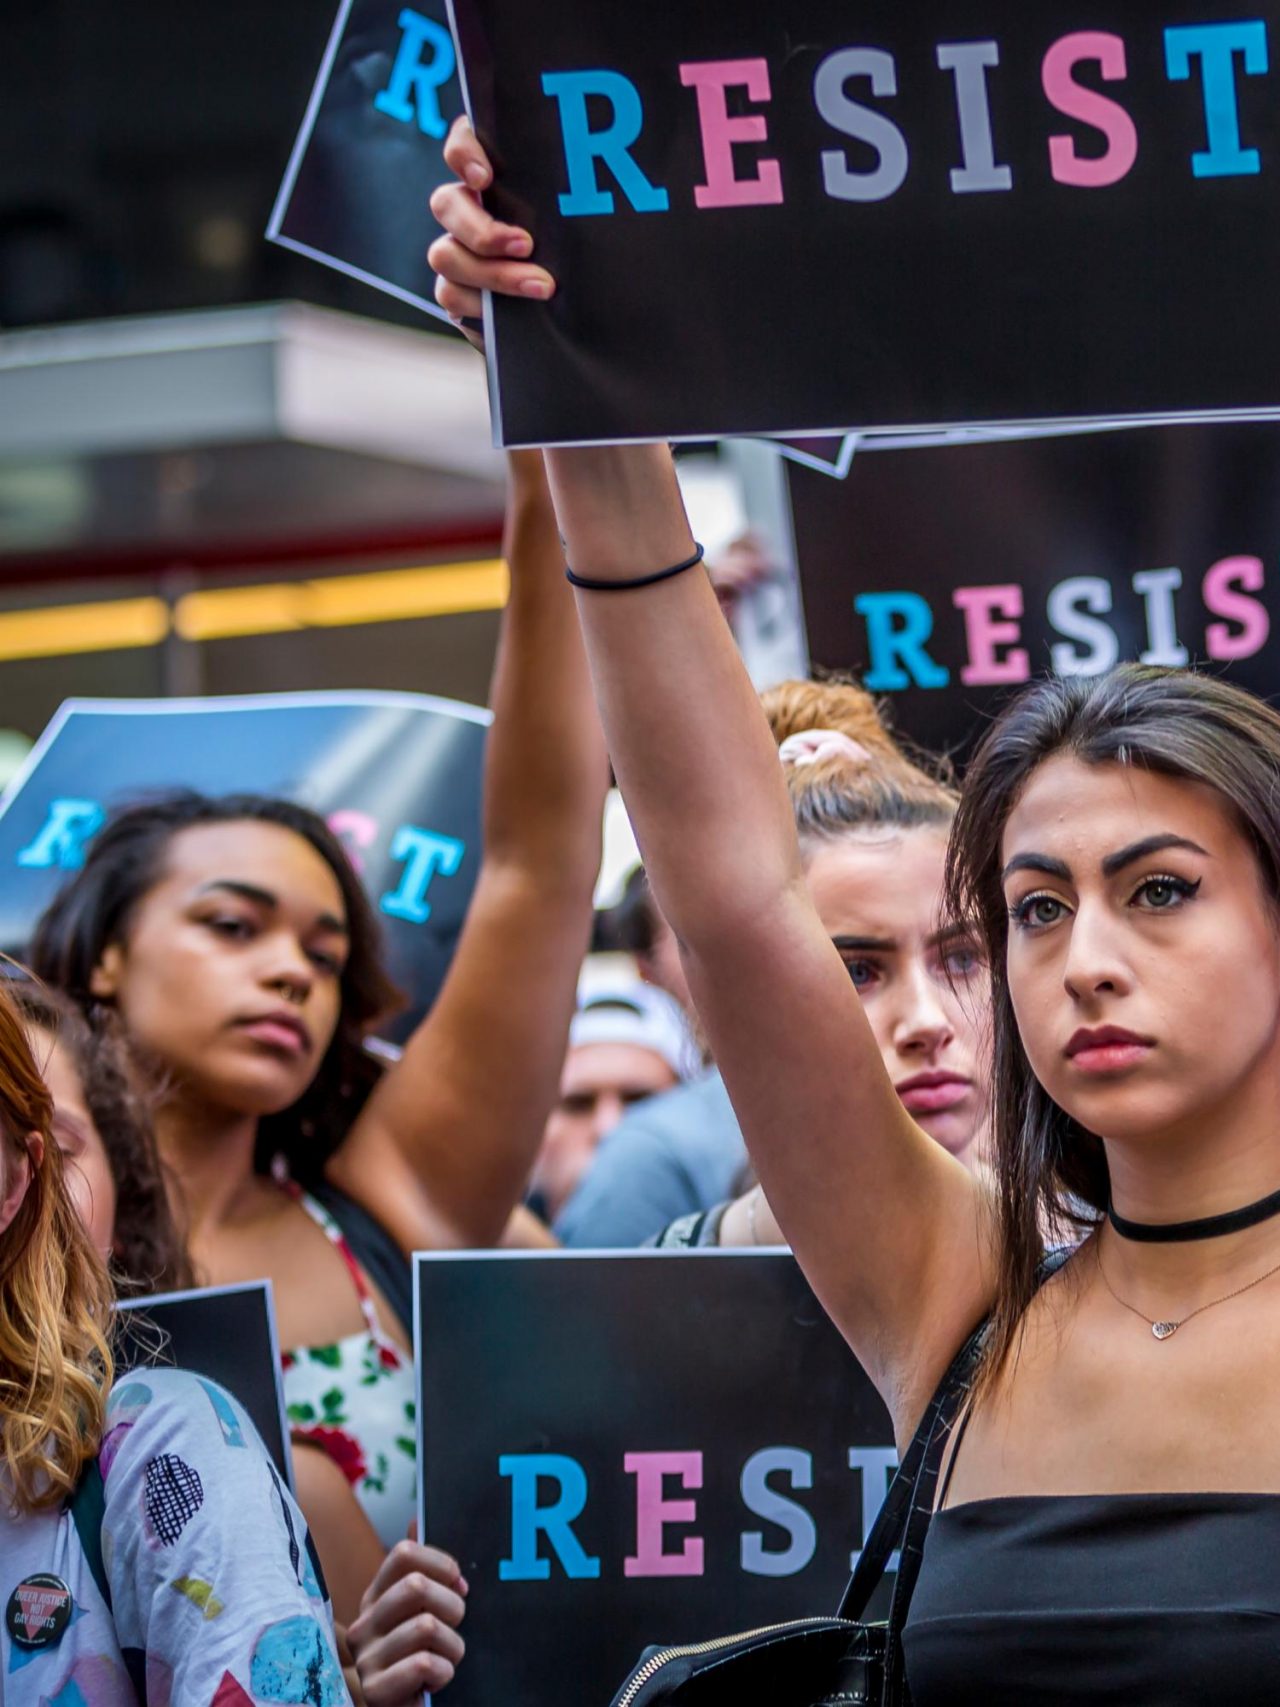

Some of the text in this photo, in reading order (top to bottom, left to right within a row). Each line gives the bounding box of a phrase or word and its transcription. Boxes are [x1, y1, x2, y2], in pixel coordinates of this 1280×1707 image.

[541, 20, 1269, 217] RESIST
[15, 1591, 67, 1608] QUEER JUSTICE
[30, 1603, 45, 1616] NOT
[14, 1612, 56, 1629] GAY RIGHTS
